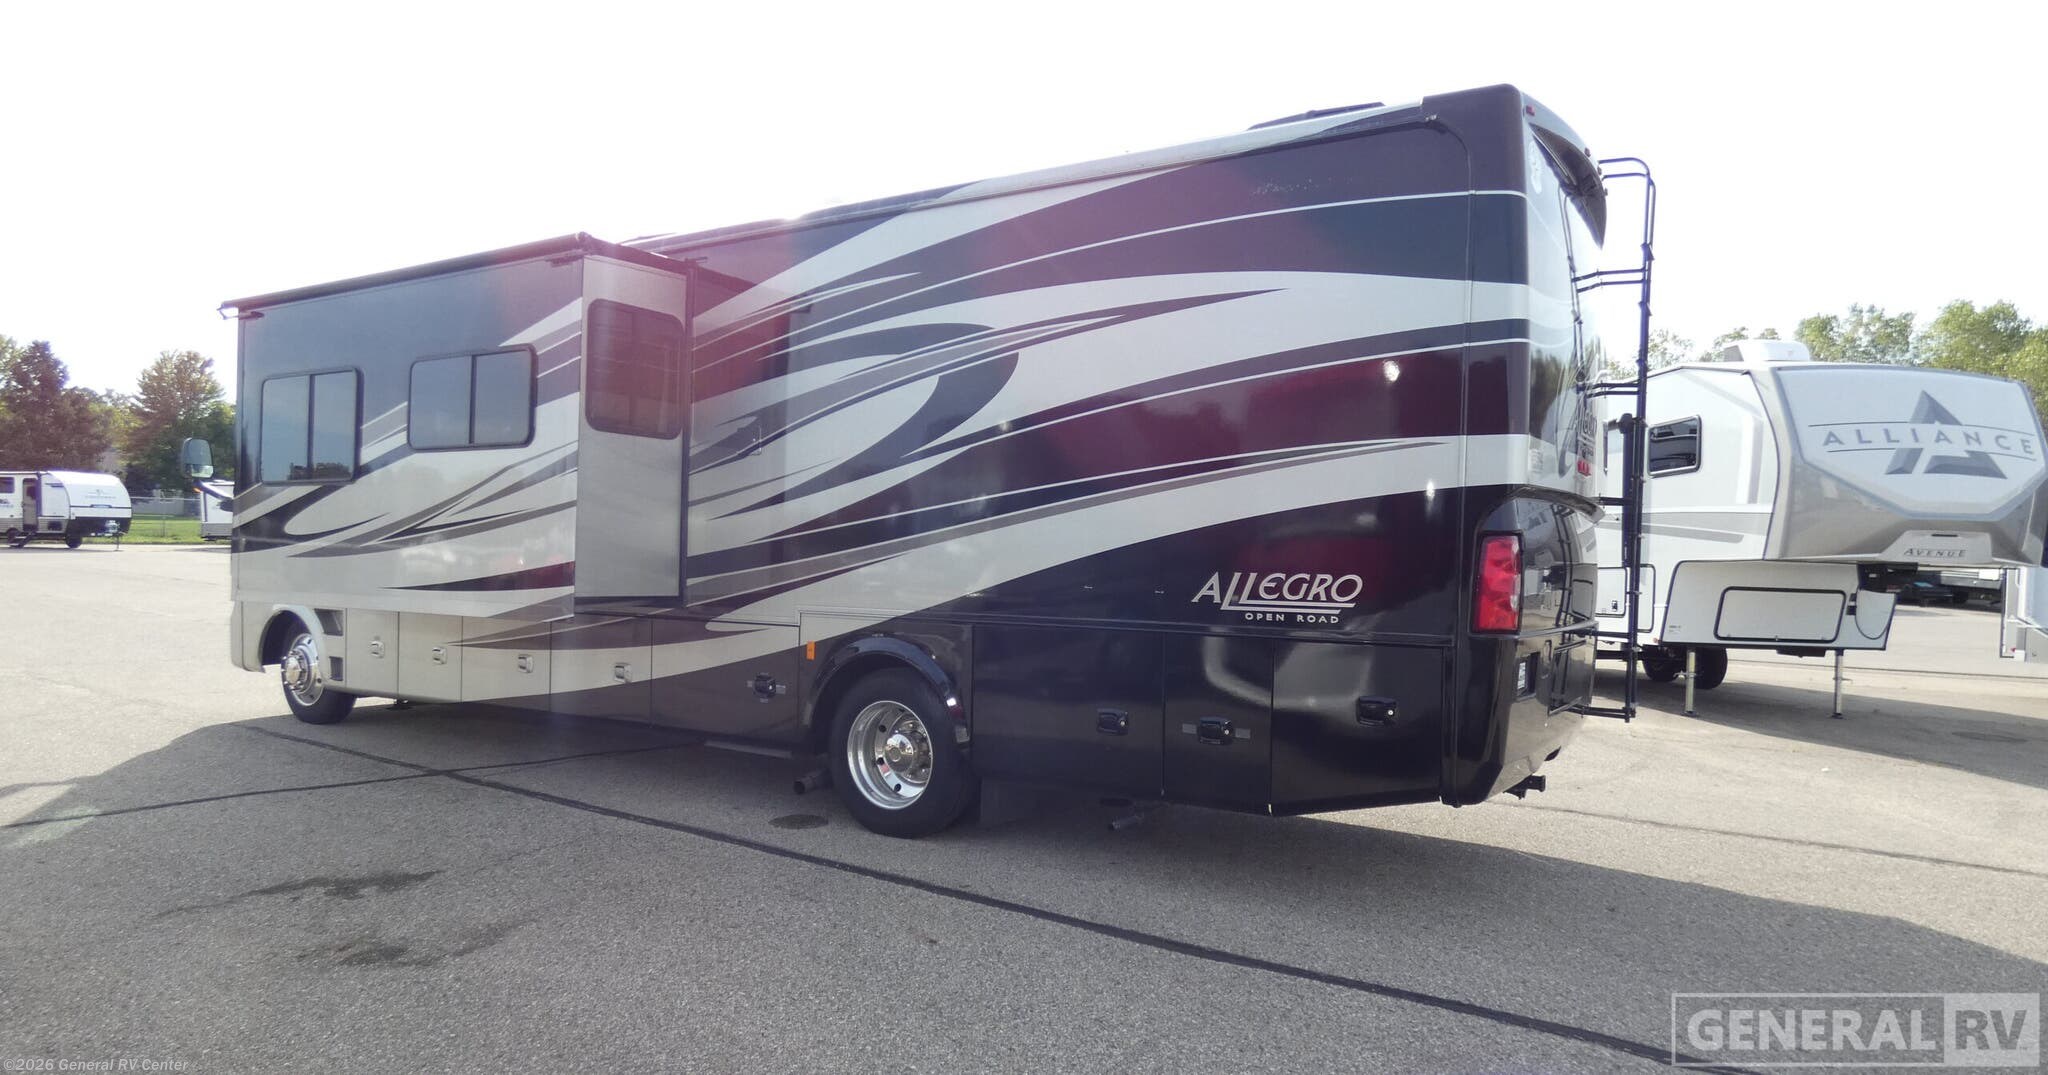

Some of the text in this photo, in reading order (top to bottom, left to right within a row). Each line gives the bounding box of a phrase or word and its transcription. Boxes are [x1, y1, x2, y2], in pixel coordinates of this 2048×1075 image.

[1822, 428, 2035, 455] ALLIANCE
[1903, 548, 1967, 558] AVENUE
[1191, 571, 1364, 614] ALLEGRO
[1245, 613, 1340, 624] OPEN ROAD
